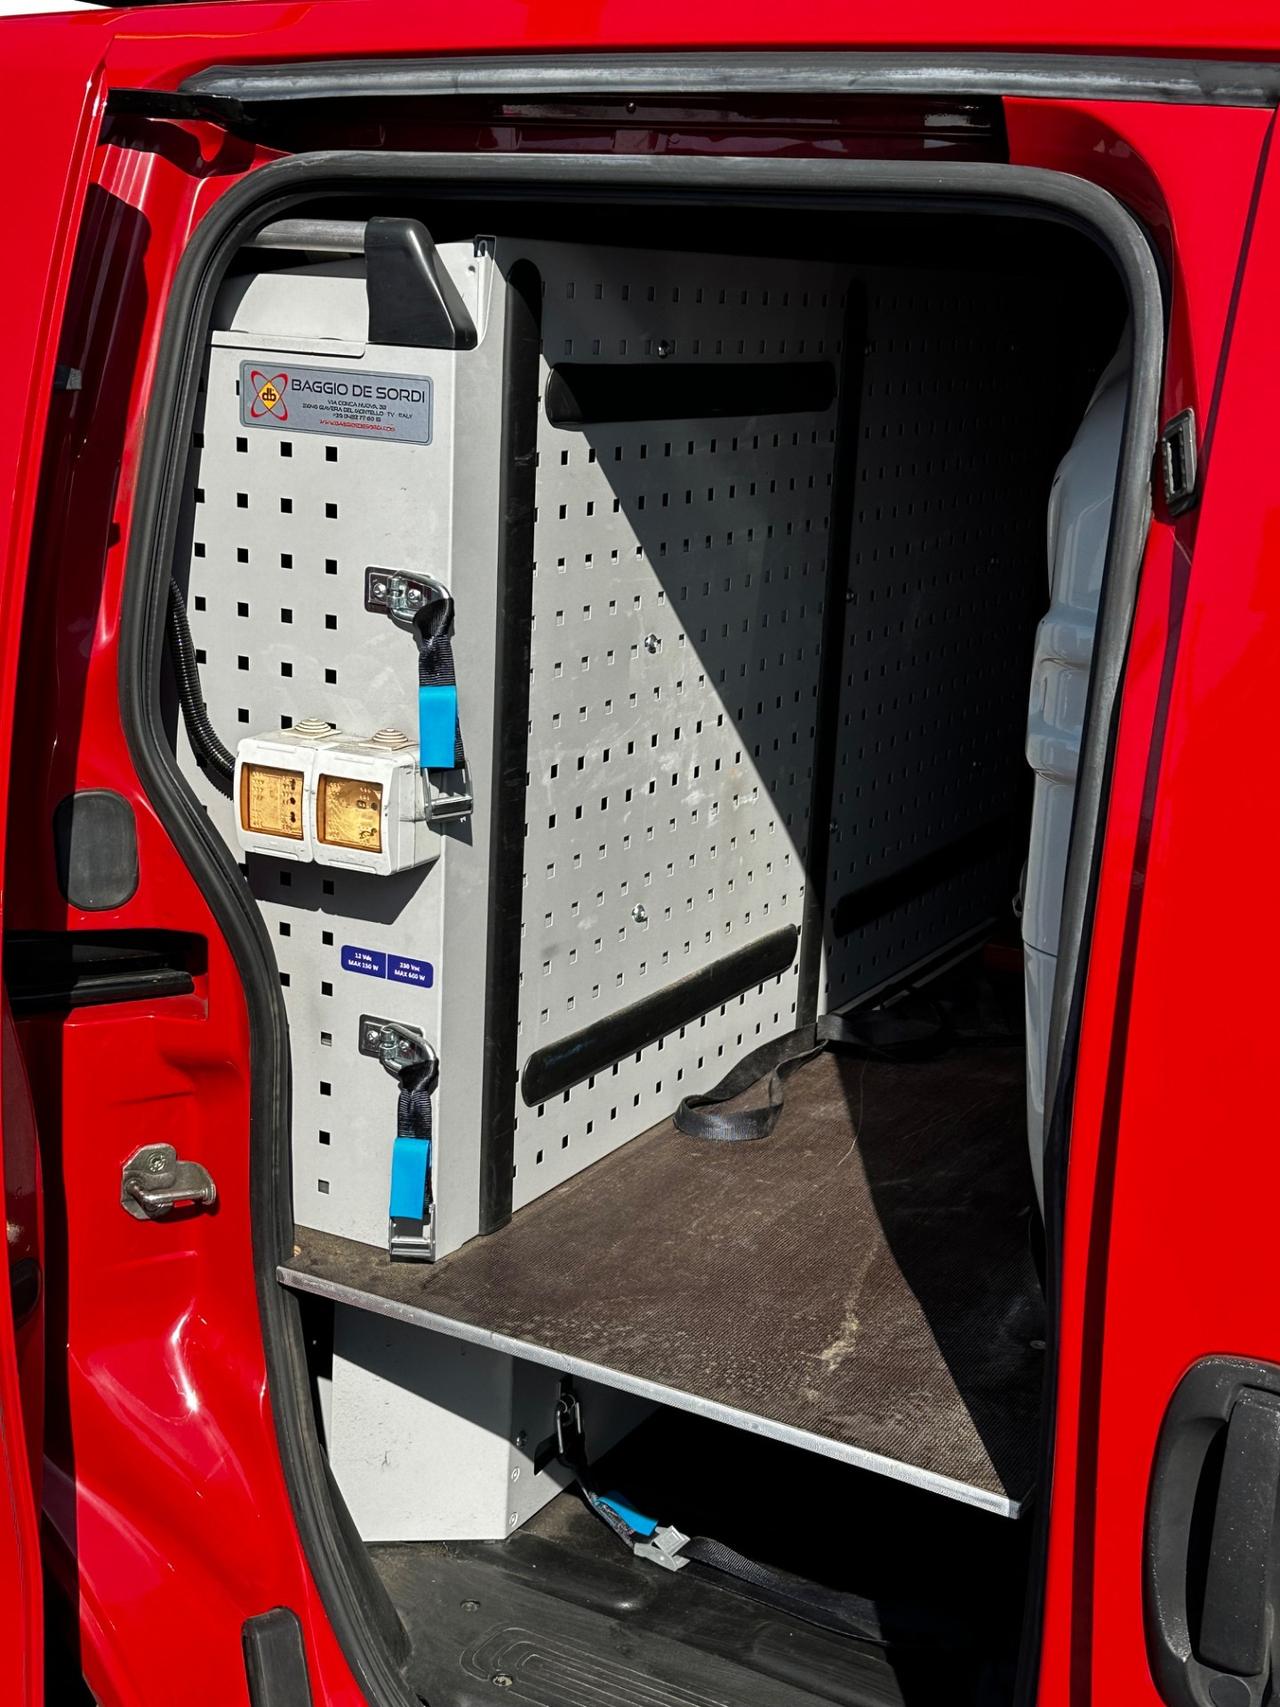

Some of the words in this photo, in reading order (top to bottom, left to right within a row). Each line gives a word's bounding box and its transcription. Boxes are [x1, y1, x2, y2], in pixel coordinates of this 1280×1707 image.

[291, 379, 348, 395] BAGGIO
[352, 384, 373, 398] DE
[376, 387, 425, 403] SORDI
[355, 952, 362, 960] 12
[348, 959, 361, 967] MAX
[362, 962, 372, 970] 150
[399, 962, 410, 970] 230
[394, 969, 408, 977] MAX
[408, 972, 418, 980] 600
